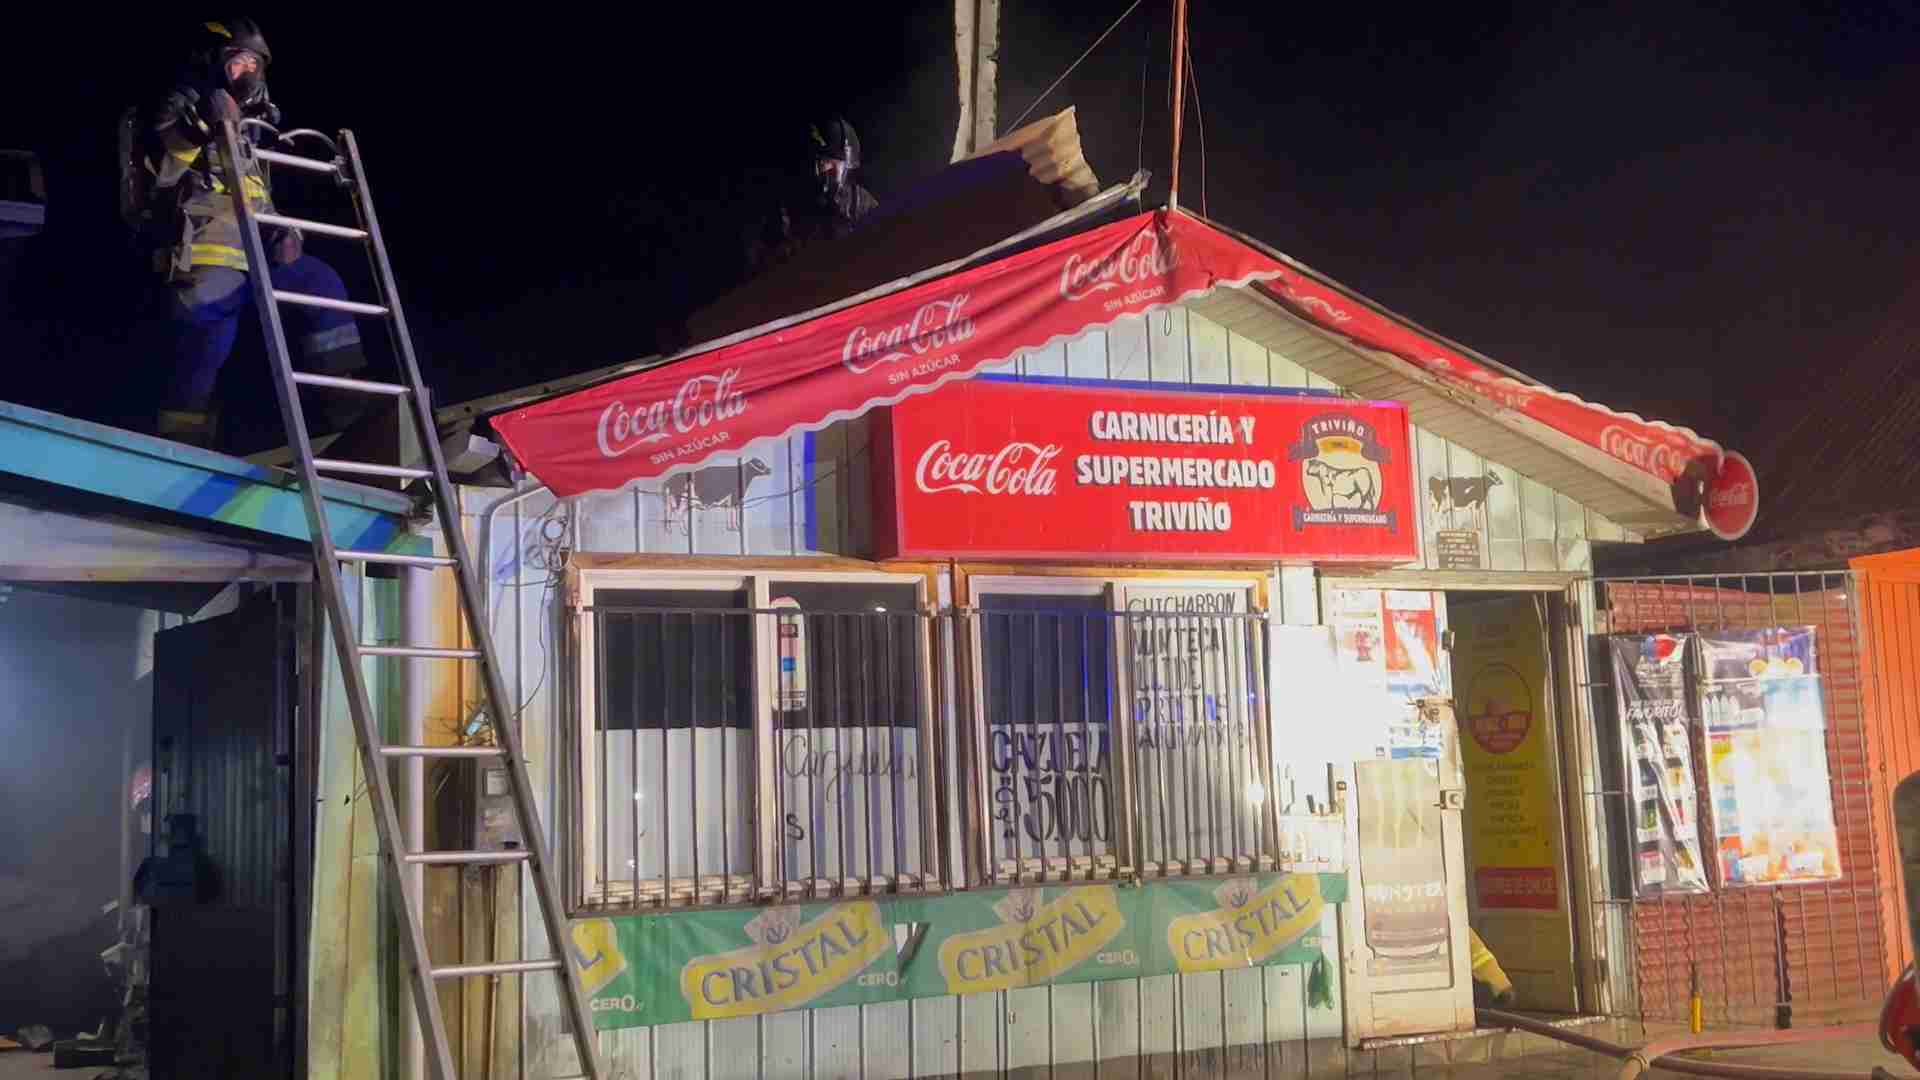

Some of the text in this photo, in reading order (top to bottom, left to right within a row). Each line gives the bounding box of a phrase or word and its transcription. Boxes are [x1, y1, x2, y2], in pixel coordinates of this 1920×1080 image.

[842, 291, 977, 374] Coca-Cola
[887, 353, 961, 385] SIN AZÚCAR
[597, 366, 749, 458] Coca-Cola
[1090, 410, 1256, 445] CARNICERÍA Y
[649, 431, 731, 465] SIN AZÚCAR
[915, 439, 1064, 496] Coca-Cola
[1076, 454, 1276, 489] SUPERMERCADO
[1128, 496, 1232, 531] TRIVIÑO
[957, 901, 1107, 982] CRISTAL
[1182, 887, 1312, 961] CRISTAL
[702, 917, 869, 1006] CRISTAL
